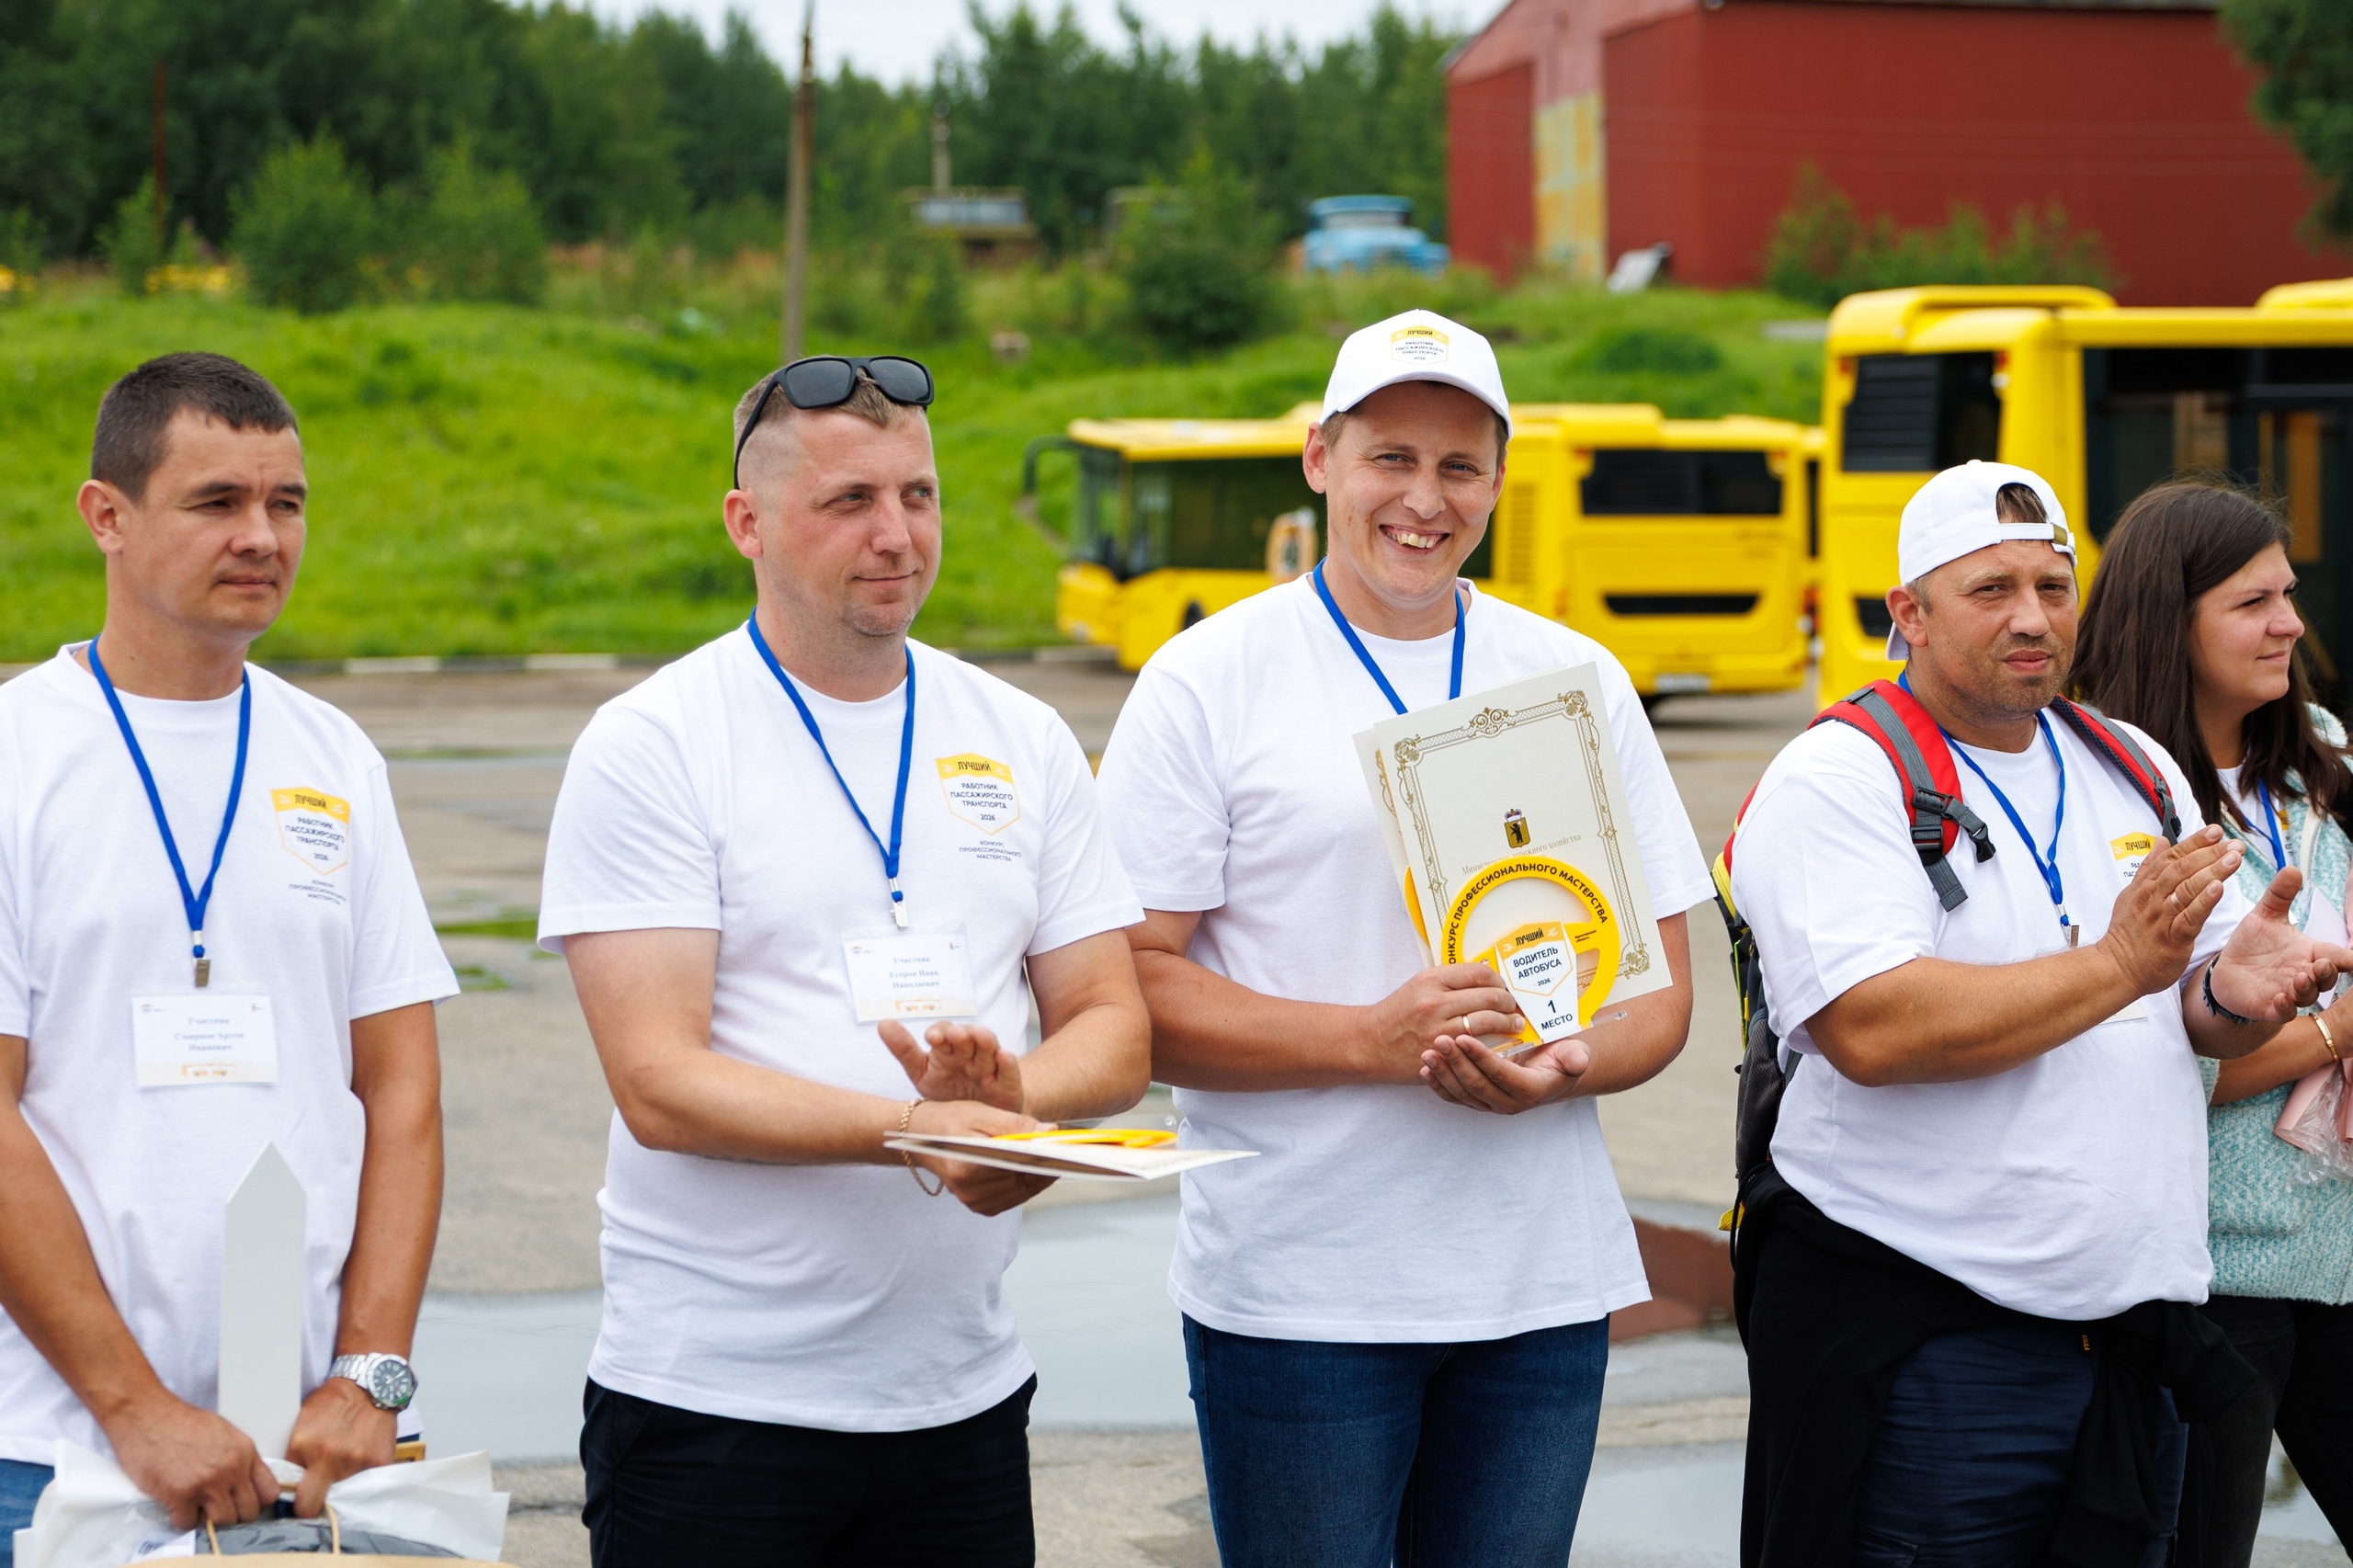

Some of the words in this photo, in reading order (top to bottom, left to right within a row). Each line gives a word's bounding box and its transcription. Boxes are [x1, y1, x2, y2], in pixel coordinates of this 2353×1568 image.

[958, 761, 991, 771] ЛУЧШИЙ
[961, 782, 998, 790] РАБОТНИК
[294, 794, 327, 809] ЛУЧШИЙ
[950, 791, 1014, 801] ПАССАЖИРСКОГО
[962, 801, 1007, 809] ТРАНСПОРТА
[1548, 834, 1582, 849] хозяйства
[2125, 838, 2152, 850] ЛУЧШИЙ
[976, 854, 1012, 862] МАСТЕРСТВА
[1453, 863, 1557, 921] ПРОФЕССИОНАЛЬНОГО
[1559, 870, 1608, 924] МАСТЕРСТВА
[1448, 922, 1459, 965] ОНКУРС
[1515, 927, 1544, 947] ЛУЧШИЙ
[1513, 947, 1559, 968] ВОДИТЕЛЬ
[1518, 959, 1563, 980] АВТОБУСА
[1537, 977, 1552, 987] 2026
[1548, 999, 1557, 1014] 1
[1540, 1013, 1574, 1030] МЕСТО
